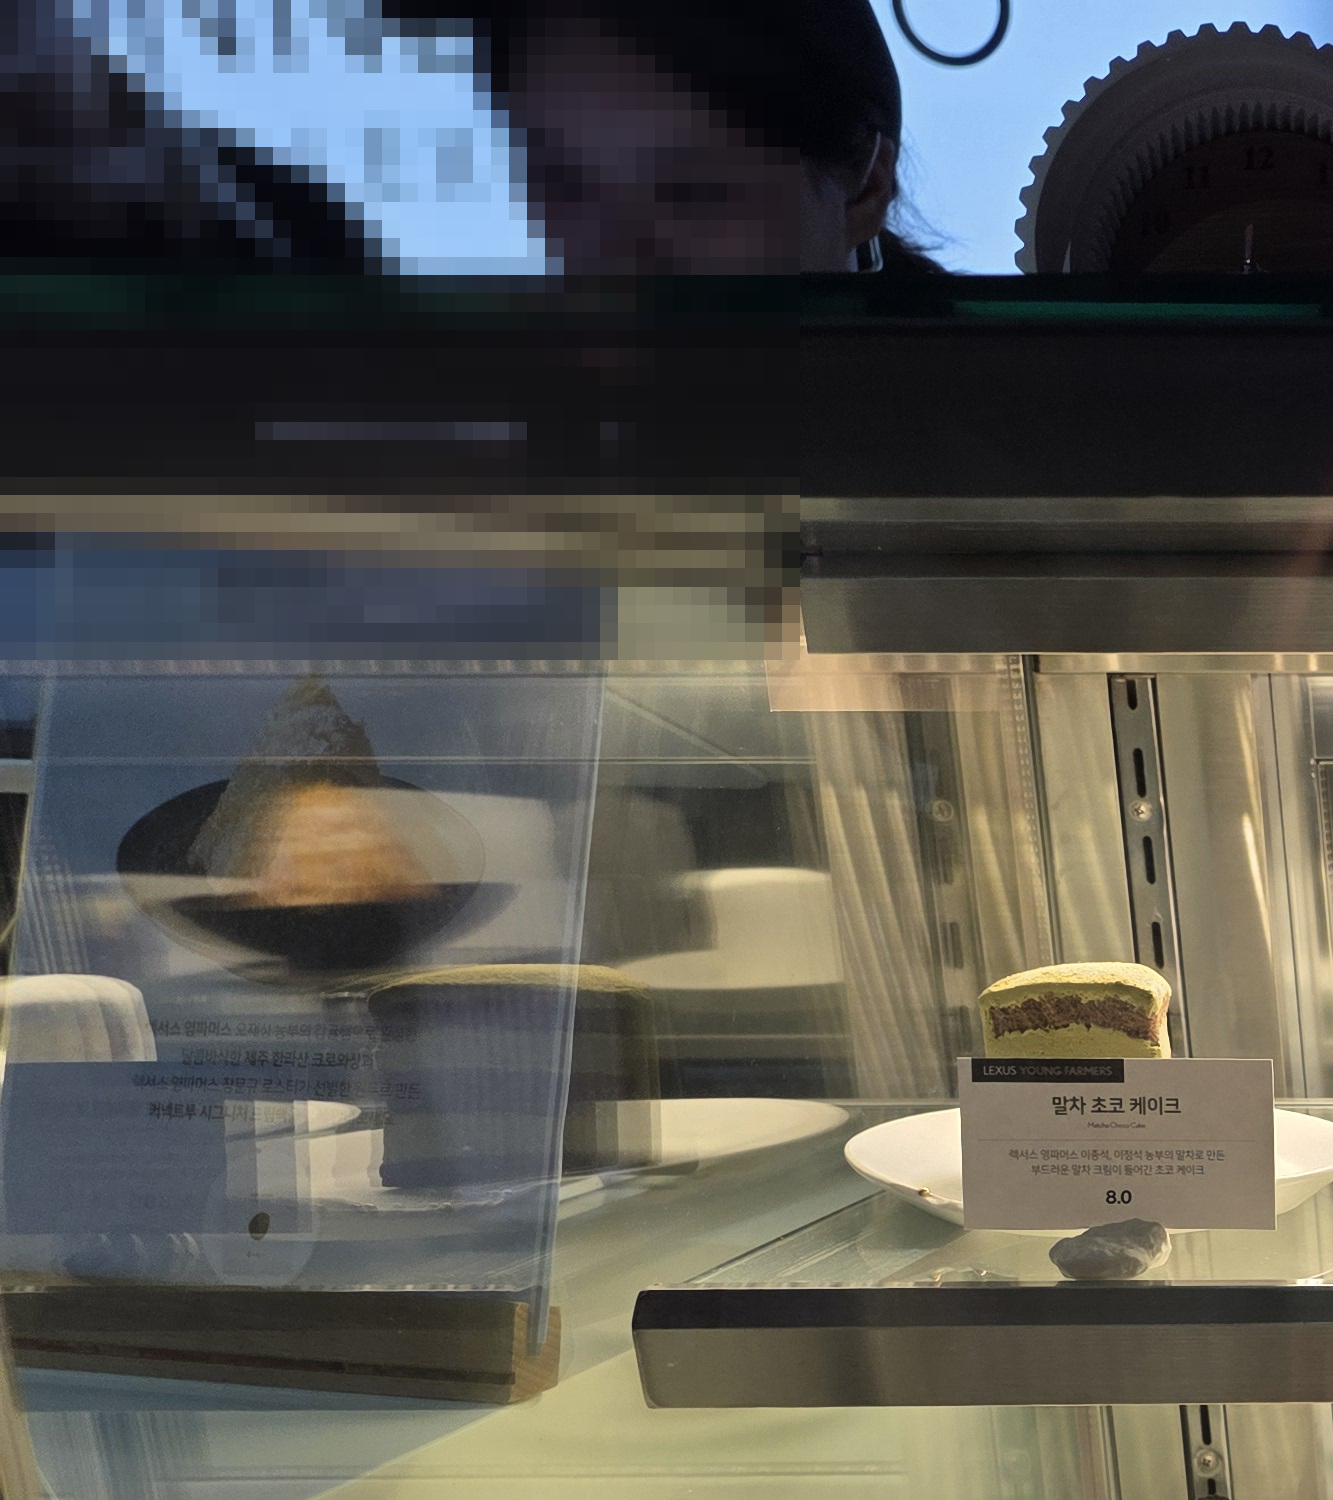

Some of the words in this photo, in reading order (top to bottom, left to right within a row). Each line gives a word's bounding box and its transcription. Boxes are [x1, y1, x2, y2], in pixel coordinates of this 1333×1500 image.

[983, 1065, 1018, 1076] LEXUS
[1019, 1065, 1063, 1076] YOUNG
[1064, 1065, 1113, 1076] FARMERS
[1051, 1095, 1087, 1116] 말차
[1090, 1096, 1126, 1114] 초코
[1129, 1096, 1182, 1116] 케이크
[1105, 1189, 1133, 1205] 8.0
